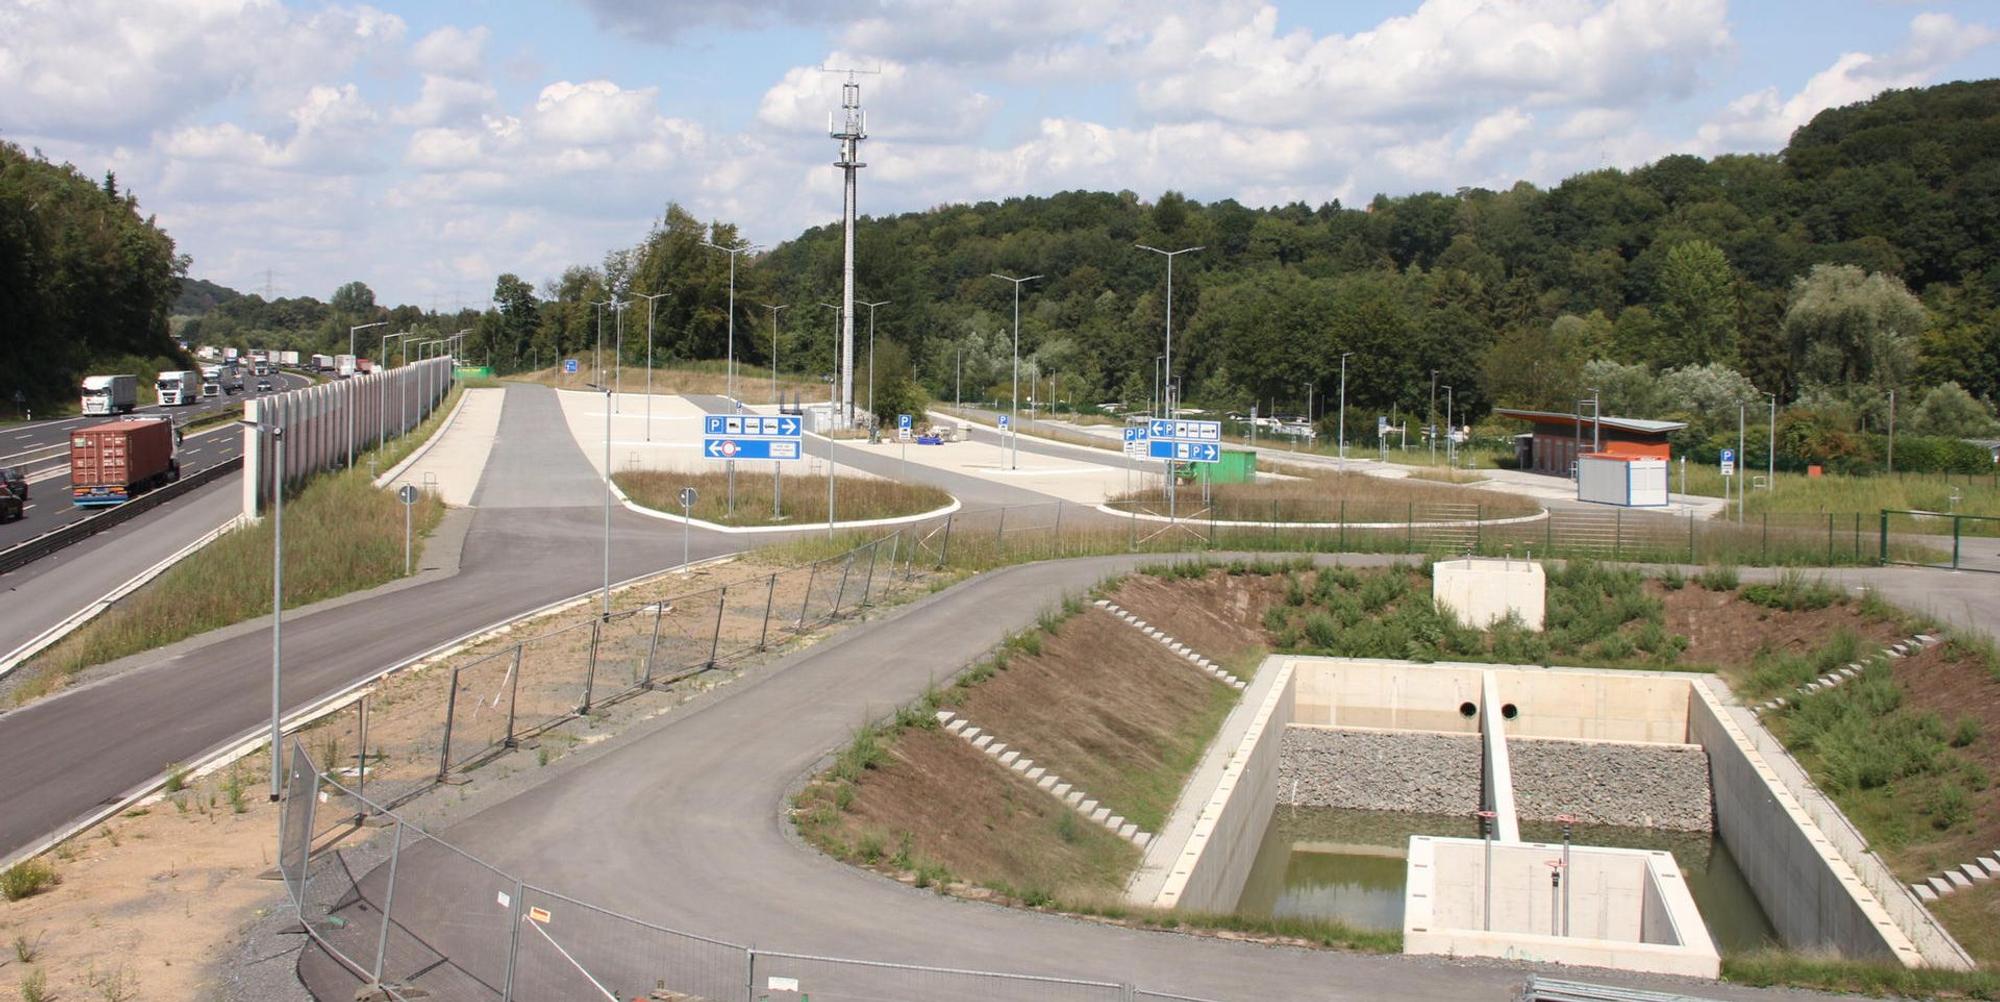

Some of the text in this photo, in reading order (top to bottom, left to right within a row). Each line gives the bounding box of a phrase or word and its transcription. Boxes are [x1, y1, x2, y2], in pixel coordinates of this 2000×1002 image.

[711, 419, 720, 431] P
[901, 416, 909, 427] P
[1138, 429, 1145, 438] P
[1166, 424, 1173, 434] P
[1126, 430, 1134, 440] P
[1193, 446, 1200, 457] P
[1723, 451, 1731, 460] P
